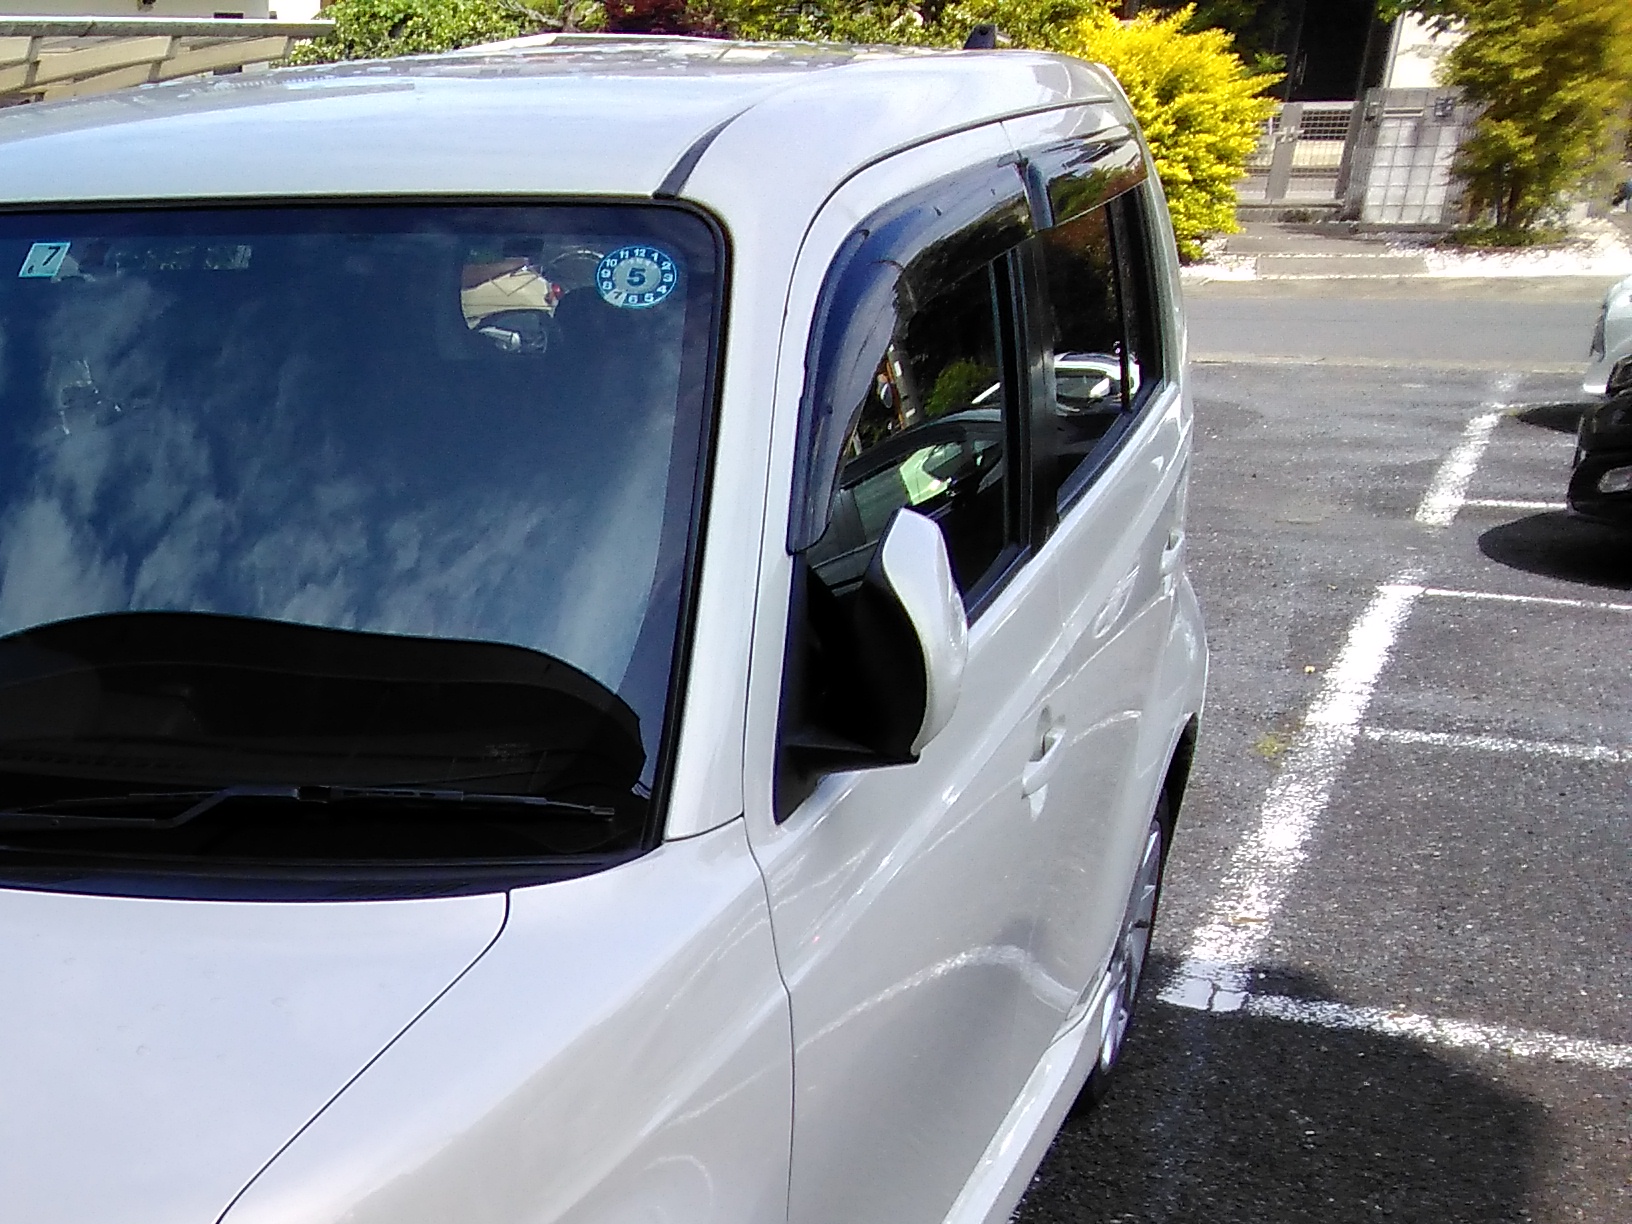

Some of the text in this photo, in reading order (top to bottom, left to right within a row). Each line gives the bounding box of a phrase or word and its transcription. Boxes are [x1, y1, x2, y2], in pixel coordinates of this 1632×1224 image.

[42, 246, 60, 266] 7
[619, 250, 629, 258] 11
[634, 248, 646, 257] 12
[651, 253, 658, 261] 1
[606, 259, 617, 267] 10
[662, 262, 671, 270] 2
[601, 269, 611, 278] 9
[627, 268, 646, 286] 5
[663, 273, 673, 282] 3
[602, 281, 612, 290] 8
[657, 285, 667, 293] 4
[644, 293, 654, 302] 5
